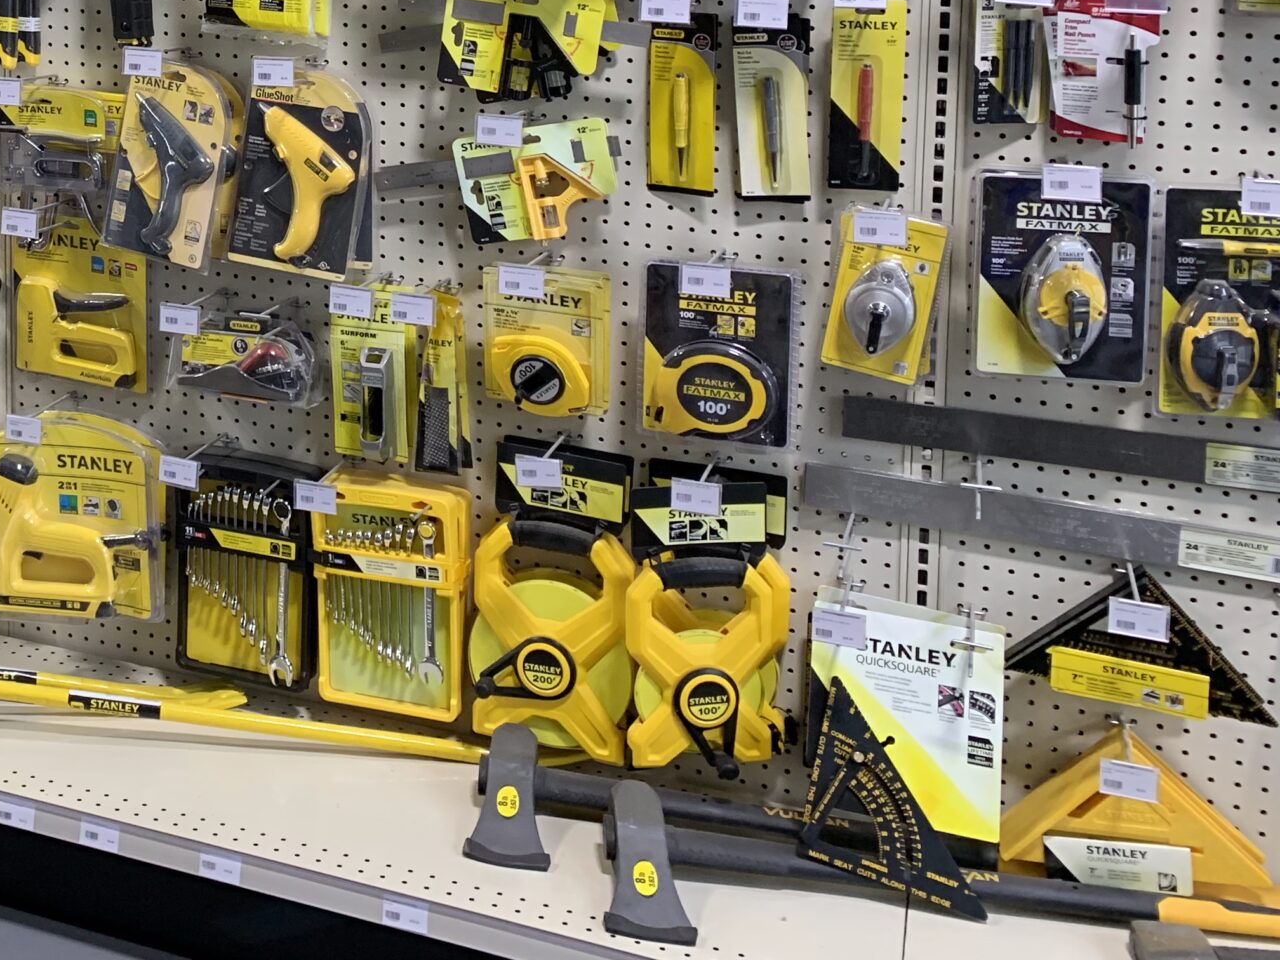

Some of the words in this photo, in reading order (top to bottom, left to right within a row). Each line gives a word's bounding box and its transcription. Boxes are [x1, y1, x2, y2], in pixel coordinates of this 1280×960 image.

[839, 20, 898, 31] STANLEY
[134, 75, 182, 93] STANLEY
[255, 88, 294, 102] GlueShot
[18, 105, 63, 115] STANLEY
[1016, 202, 1110, 220] STANLEY
[1026, 221, 1099, 231] FATMAX
[686, 301, 747, 314] FATMAX
[679, 311, 695, 320] 100'
[229, 322, 260, 330] STANLEY
[340, 330, 377, 338] SURFORM
[694, 377, 735, 389] STANLEY
[685, 388, 745, 399] FATMAX
[697, 400, 731, 415] 100'
[57, 454, 131, 474] STANLEY
[352, 513, 419, 526] STANLEY
[1227, 539, 1269, 551] STANLEY
[524, 663, 561, 674] STANLEY
[856, 654, 937, 678] QUICKSQUARE
[532, 674, 556, 684] 200'
[1102, 666, 1156, 683] STANLEY
[90, 699, 140, 713] STANLEY
[688, 694, 728, 705] STANLEY
[698, 706, 721, 716] 100'
[816, 737, 826, 755] CUTS
[811, 758, 821, 782] ALONG
[807, 785, 816, 801] THIS
[1086, 845, 1148, 859] STANLEY
[808, 850, 829, 863] MARK
[833, 859, 853, 870] SEAT
[857, 868, 876, 880] CUTS
[881, 877, 905, 890] ALONG
[911, 888, 927, 900] THIS
[931, 896, 951, 908] EDGE
[926, 872, 959, 888] STANLEY
